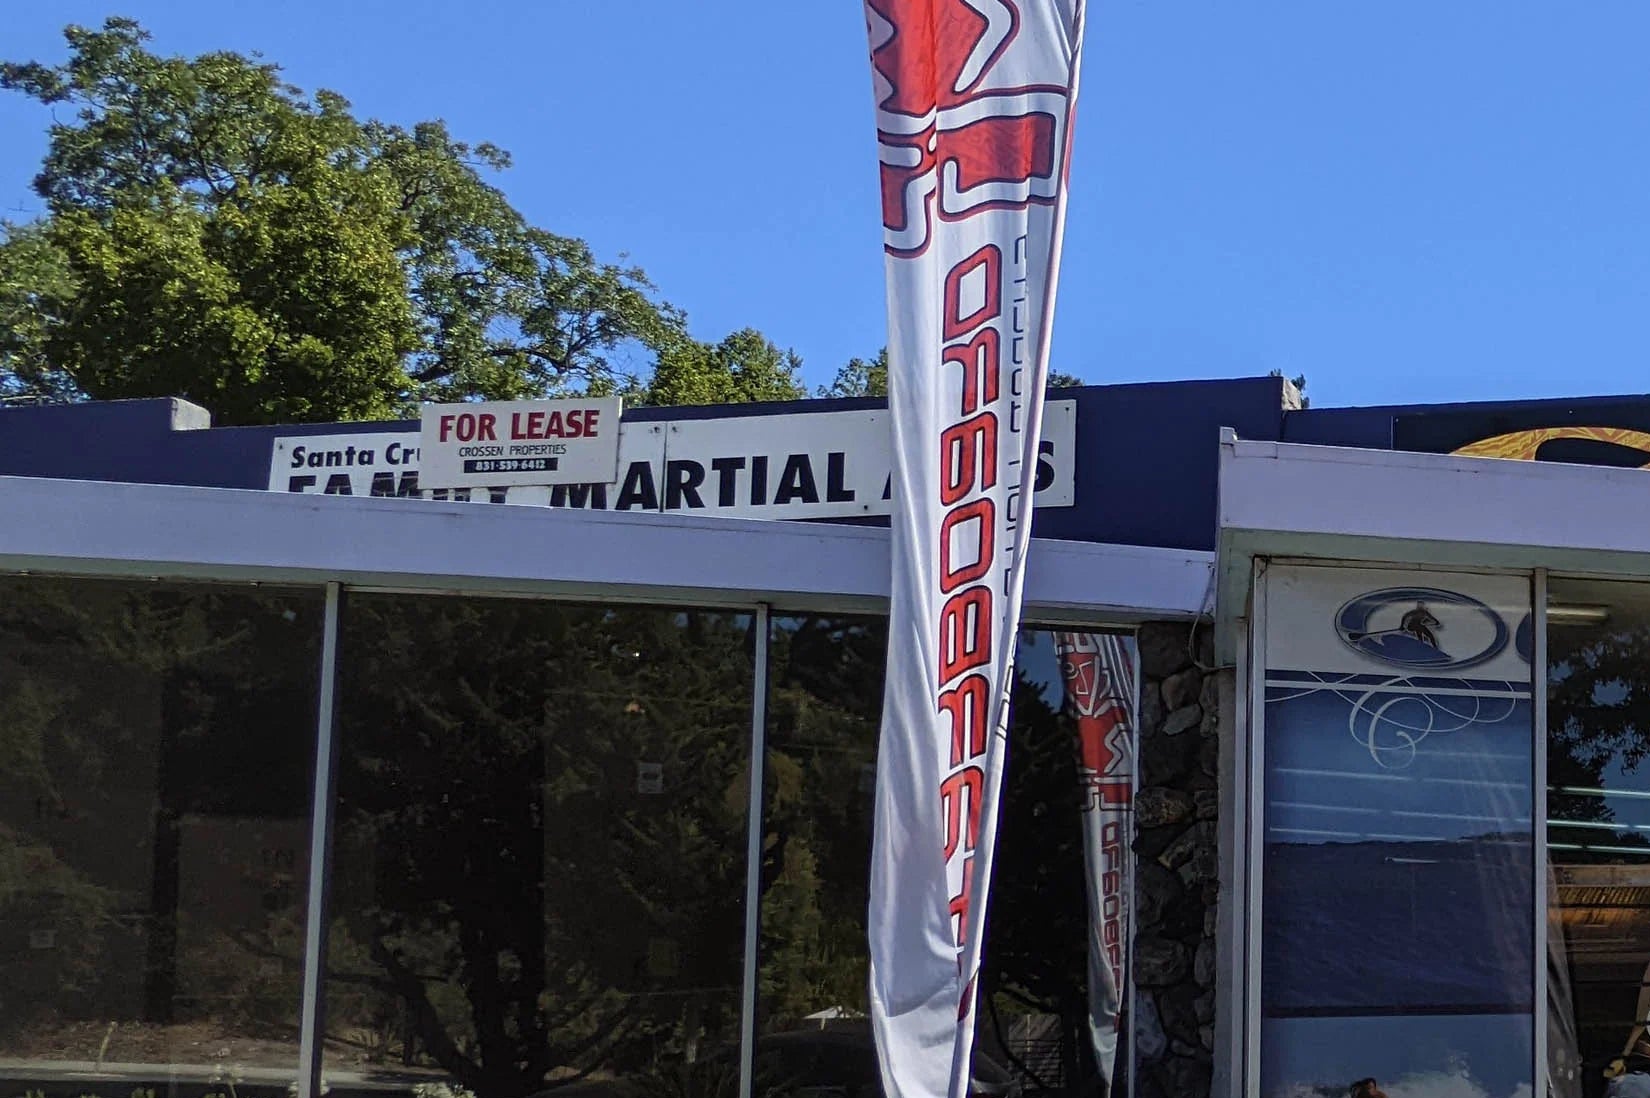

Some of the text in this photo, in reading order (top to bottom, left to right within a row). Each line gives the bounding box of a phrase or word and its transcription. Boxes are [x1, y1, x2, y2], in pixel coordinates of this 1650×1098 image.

[439, 409, 600, 442] FOR LEASE
[291, 442, 421, 468] Santa Cr
[458, 444, 567, 457] CROSSEN PROPERTIES
